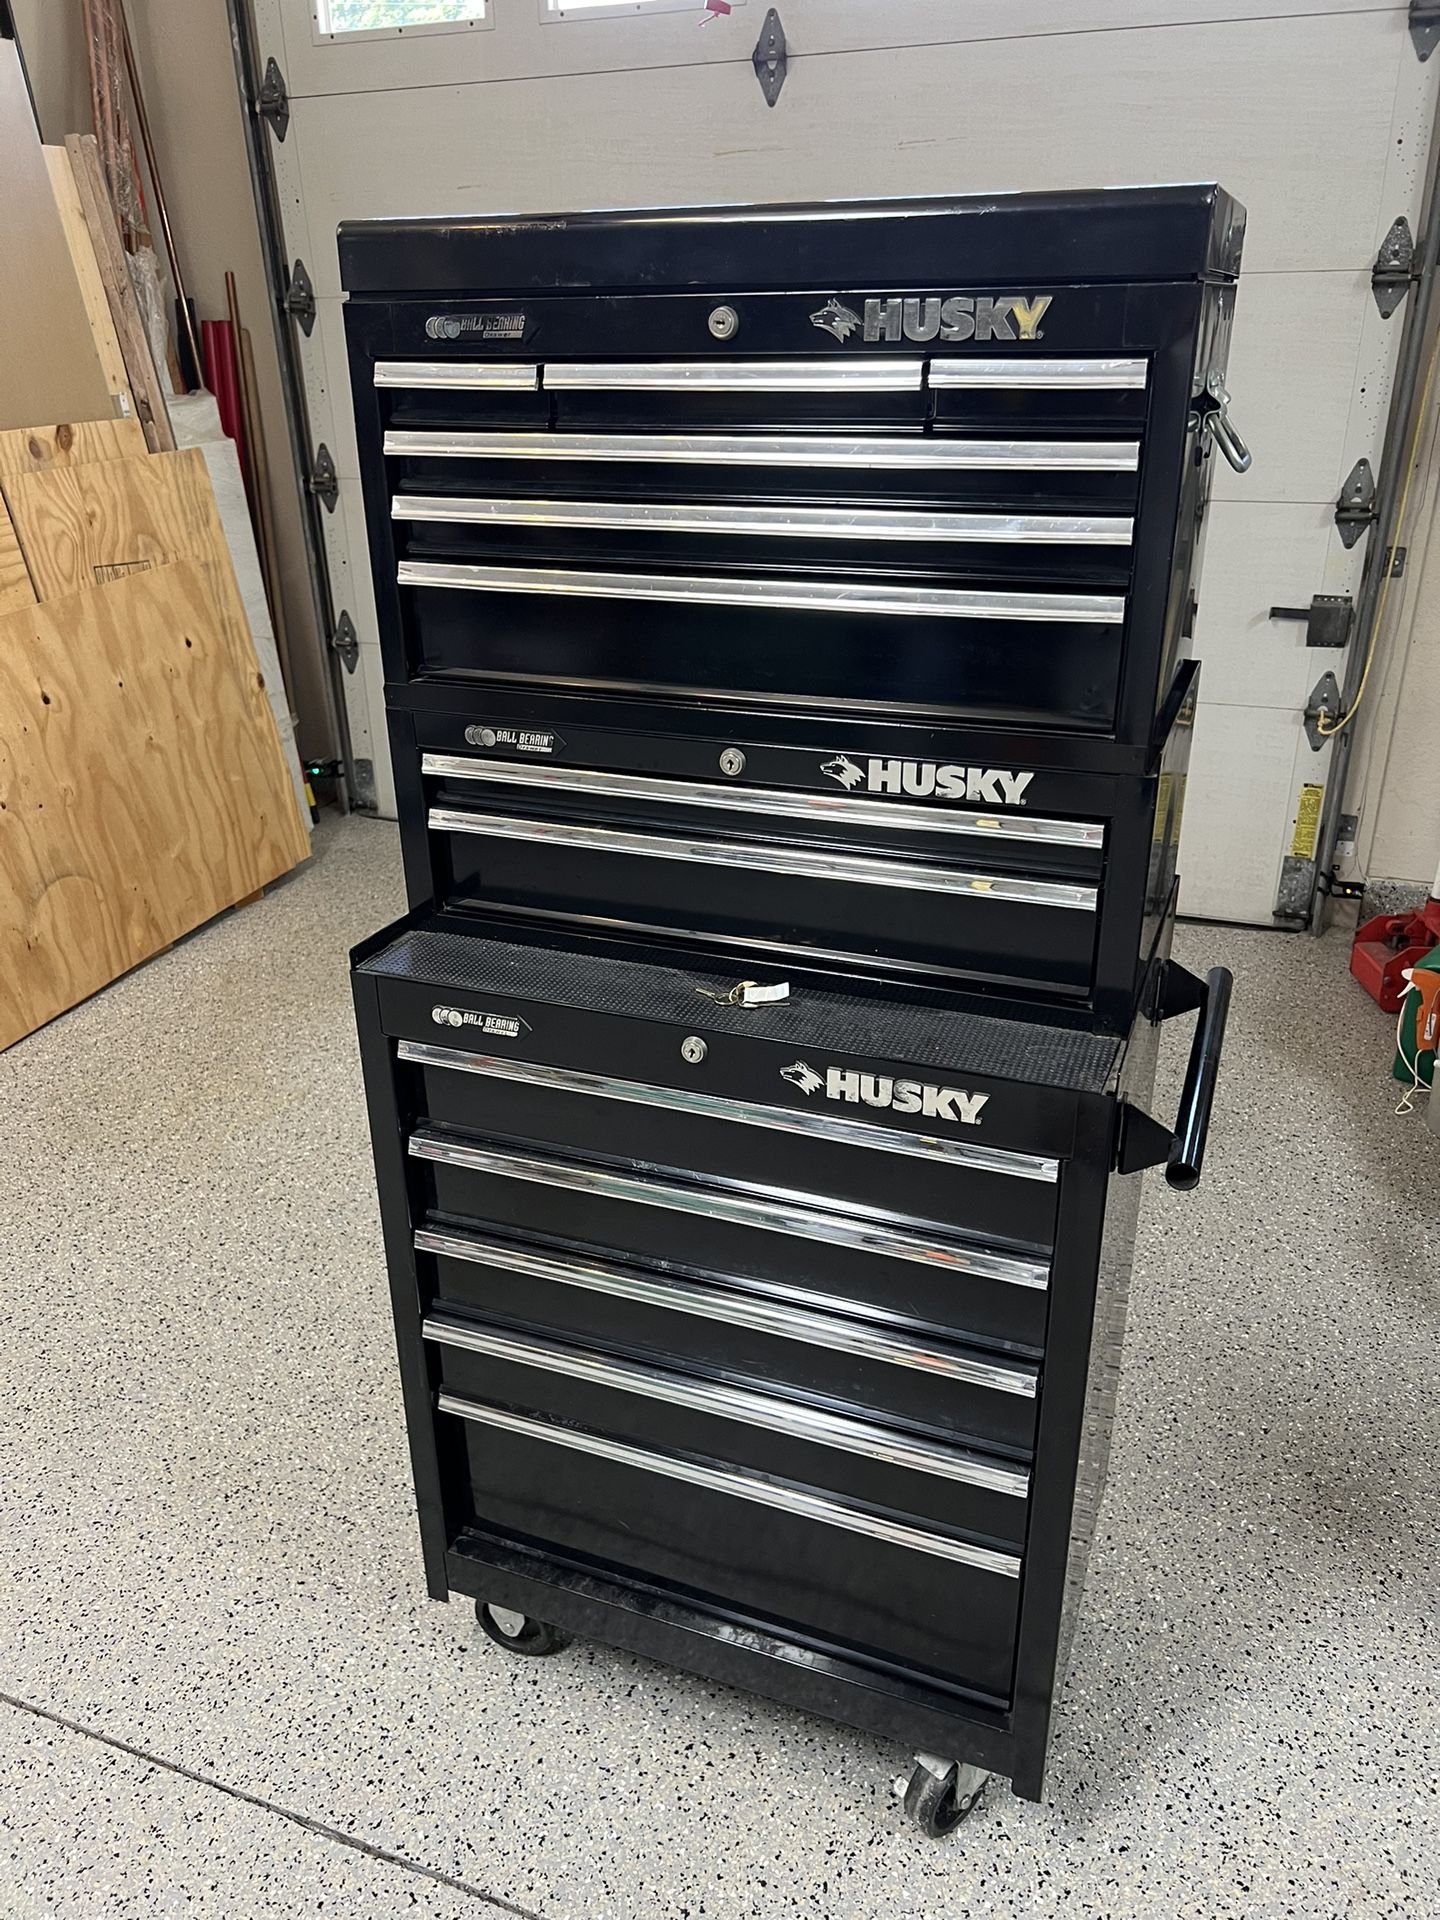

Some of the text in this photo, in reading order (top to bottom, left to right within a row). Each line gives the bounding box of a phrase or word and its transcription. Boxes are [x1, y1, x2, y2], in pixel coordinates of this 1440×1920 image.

[864, 296, 1053, 342] HUSKY
[496, 730, 554, 747] BALL BEARING
[867, 759, 1035, 806] HUSKY
[463, 1013, 520, 1032] BALL BEARING
[826, 1066, 991, 1125] HUSKY
